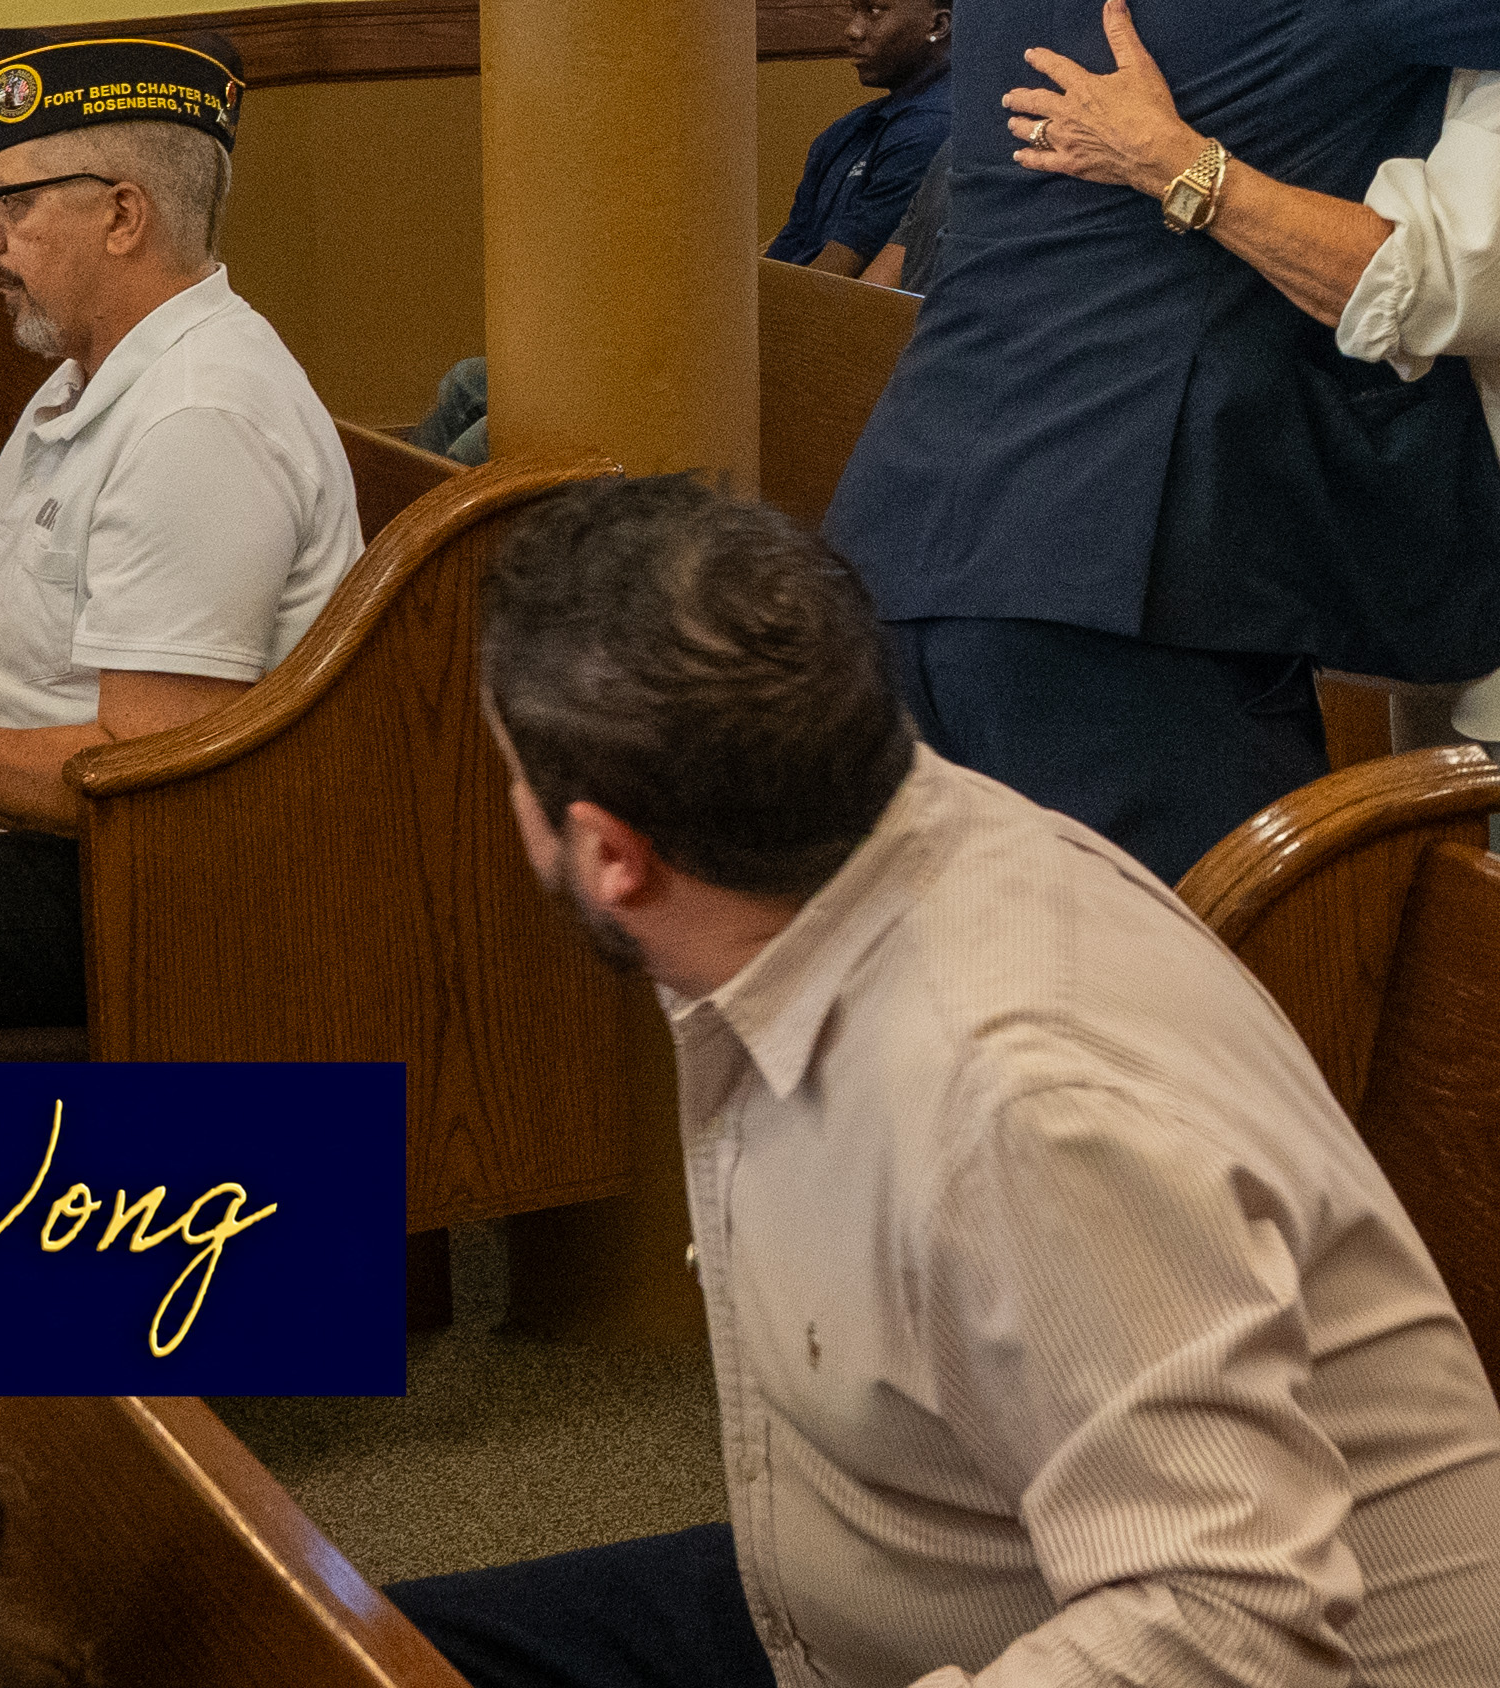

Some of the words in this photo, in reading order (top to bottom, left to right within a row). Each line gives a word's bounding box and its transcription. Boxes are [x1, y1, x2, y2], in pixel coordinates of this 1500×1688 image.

[44, 89, 85, 108] FORT
[89, 83, 131, 99] BEND
[136, 82, 201, 102] CHAPTER
[83, 97, 182, 115] ROSENBERG,
[184, 102, 201, 117] TX
